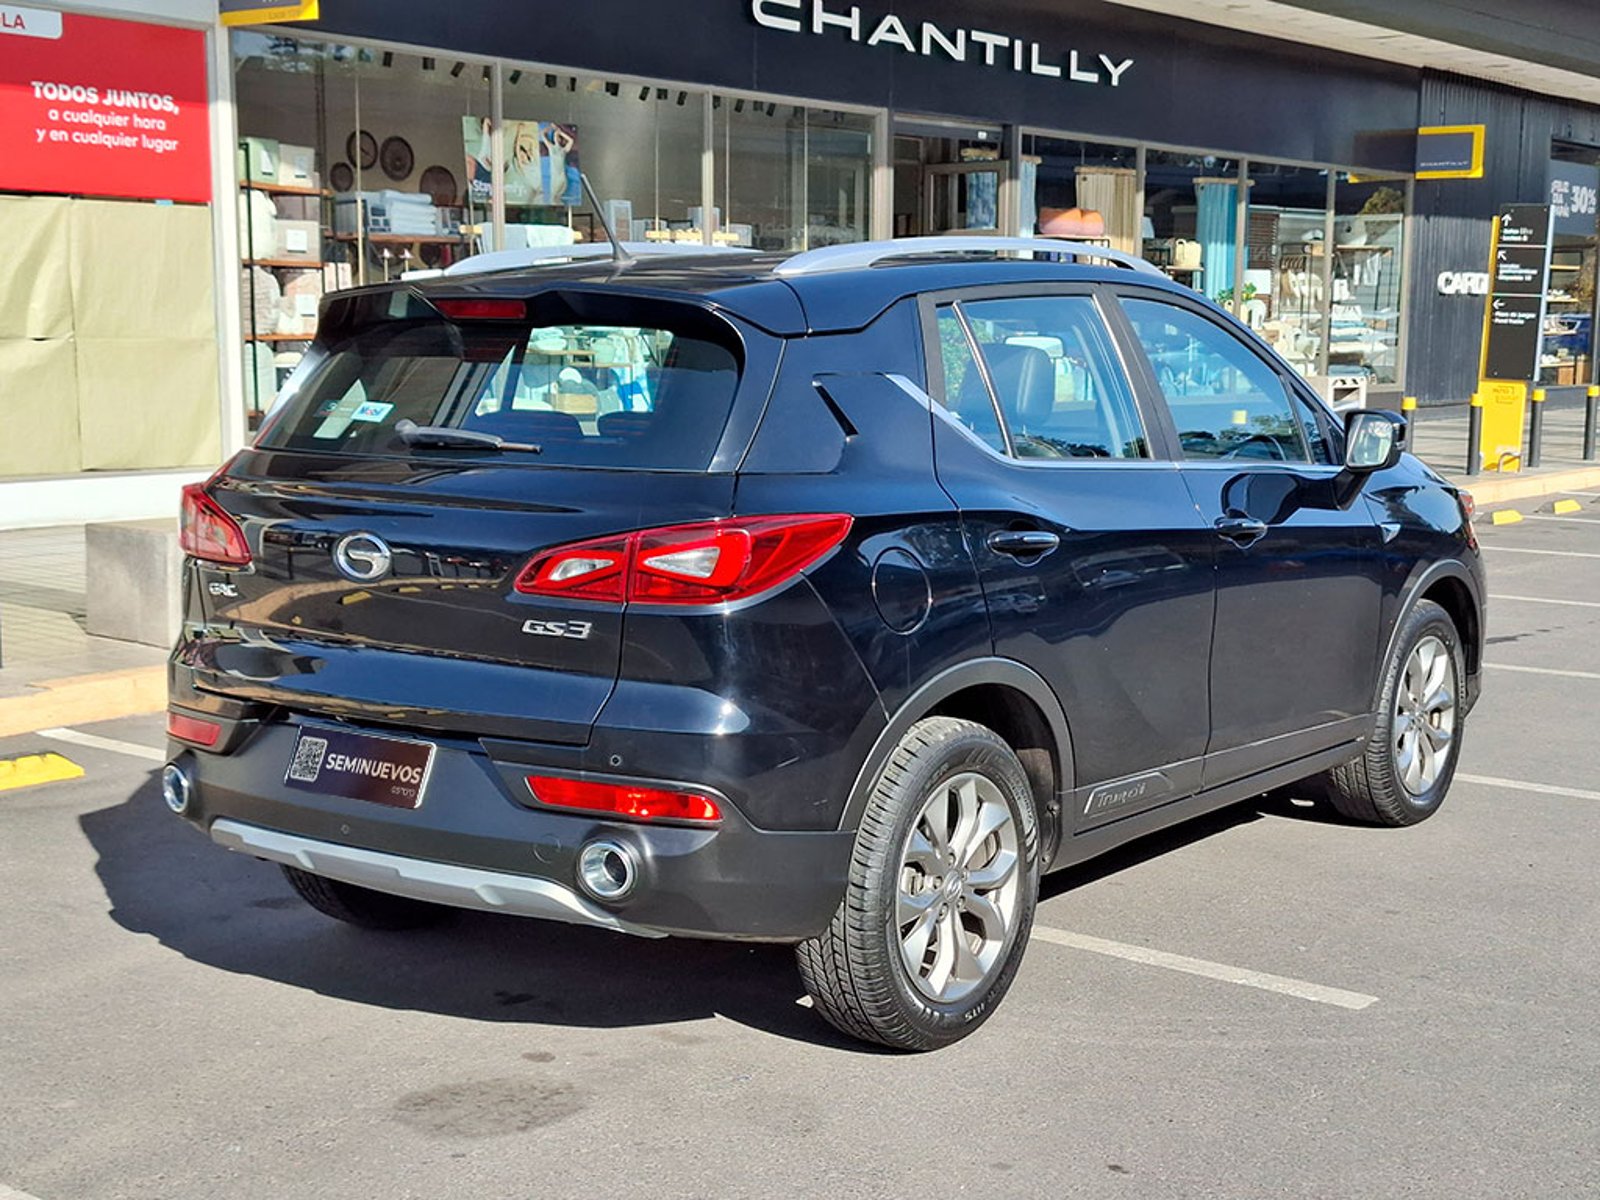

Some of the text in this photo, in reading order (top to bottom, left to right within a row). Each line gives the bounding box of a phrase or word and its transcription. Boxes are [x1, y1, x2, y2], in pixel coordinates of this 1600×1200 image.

[752, 0, 1134, 87] CHANTILLY
[31, 81, 180, 115] TODOS JUNTOS,
[48, 109, 167, 131] a cualquier hora
[35, 128, 178, 153] y en cualquier lugar
[521, 619, 593, 639] GS3
[325, 753, 423, 785] SEMINUEVOS
